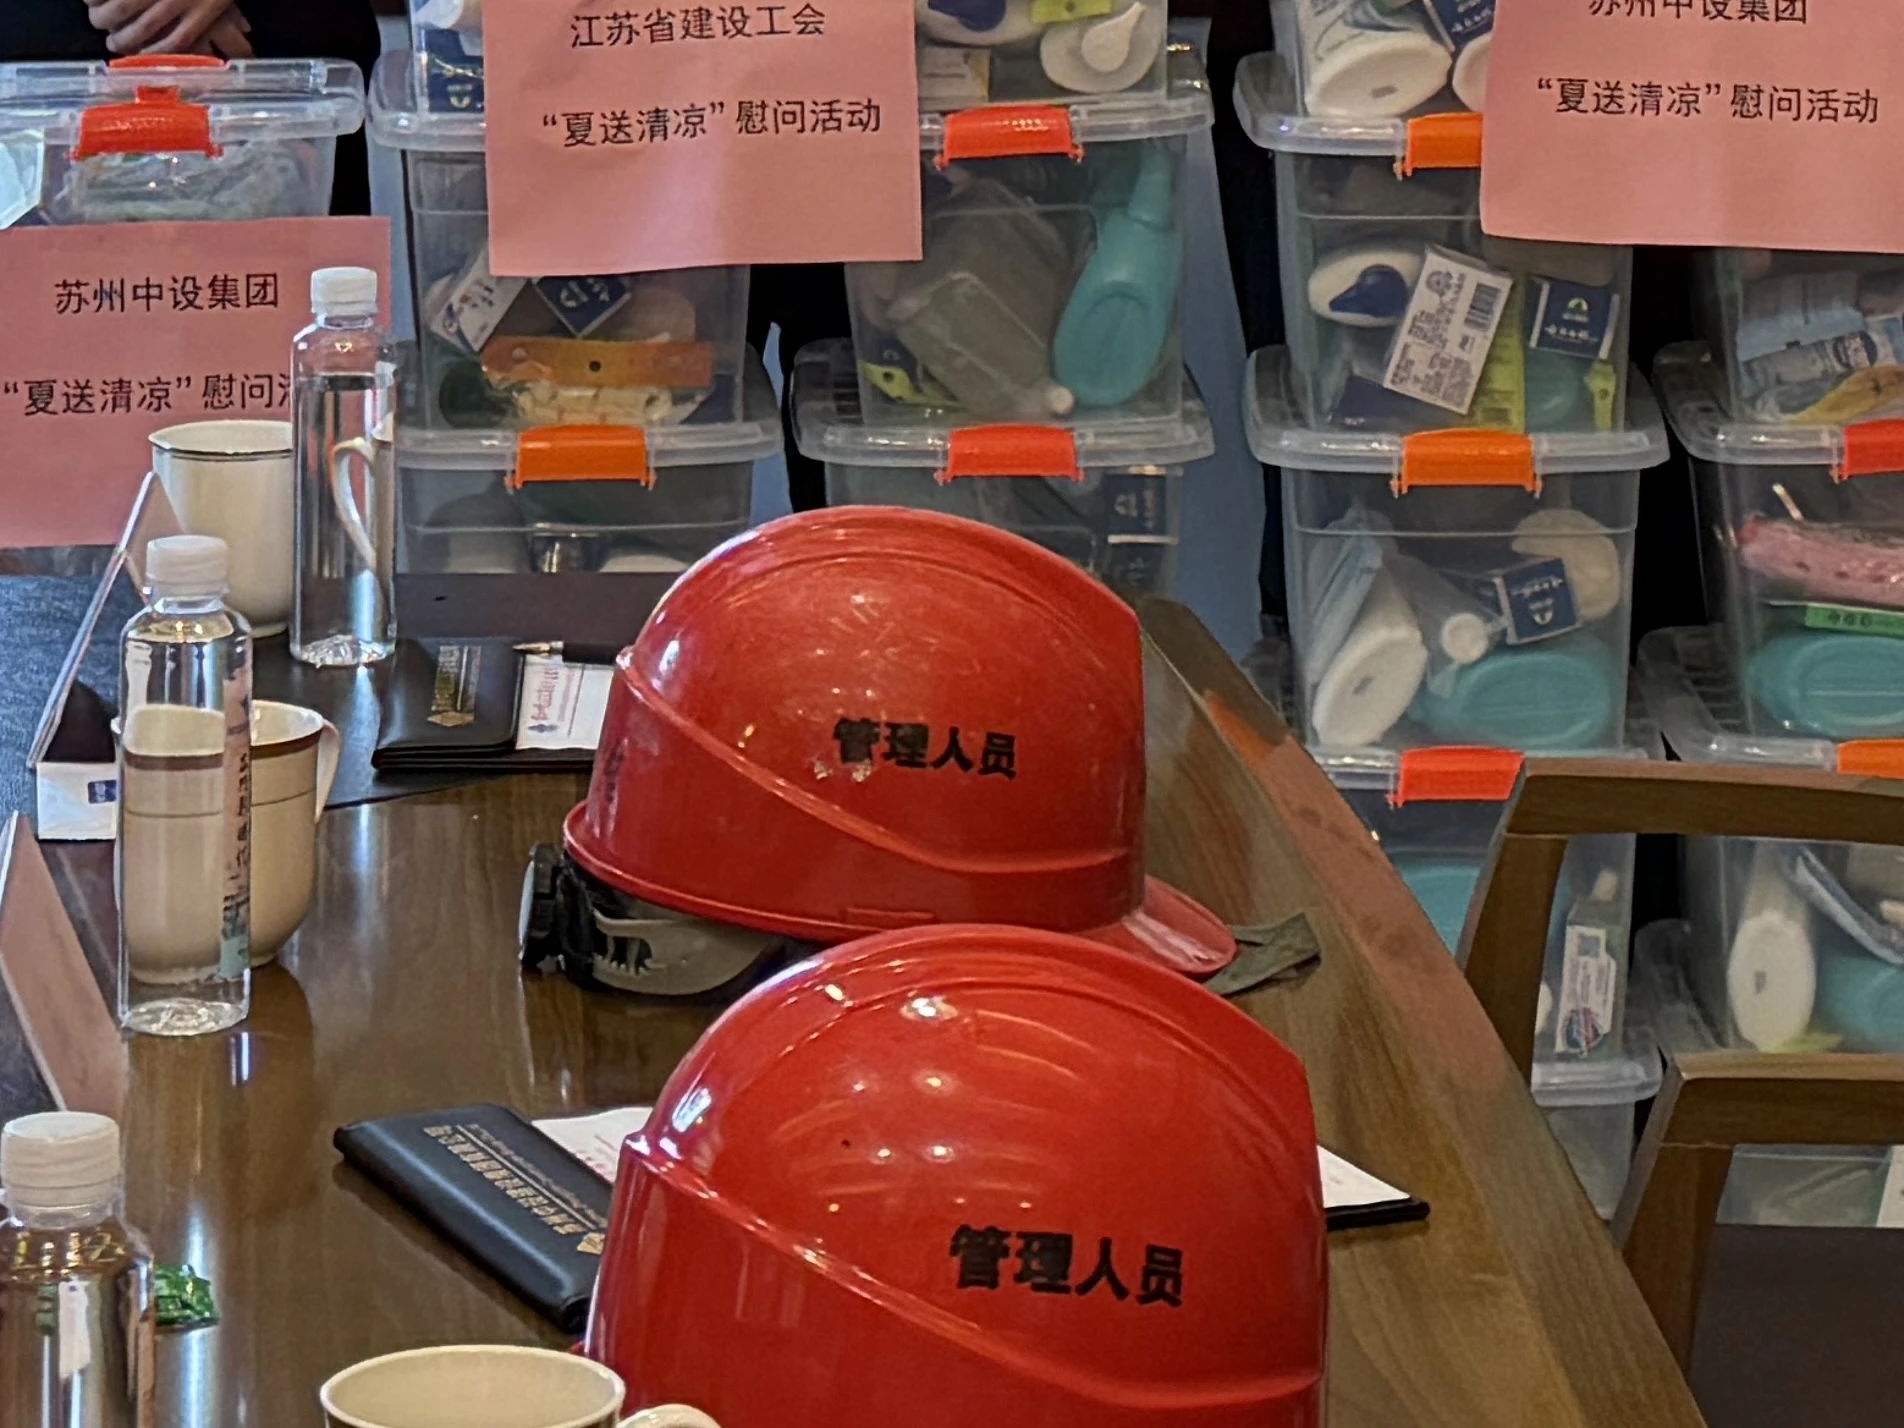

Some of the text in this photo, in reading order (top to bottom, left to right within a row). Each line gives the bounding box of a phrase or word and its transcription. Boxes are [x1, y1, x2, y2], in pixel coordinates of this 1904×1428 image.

[571, 3, 825, 49] 江苏省建设工会
[54, 272, 280, 314] 苏州中设集团
[831, 716, 1018, 780] 管理人员
[950, 1222, 1184, 1307] 管理人员
